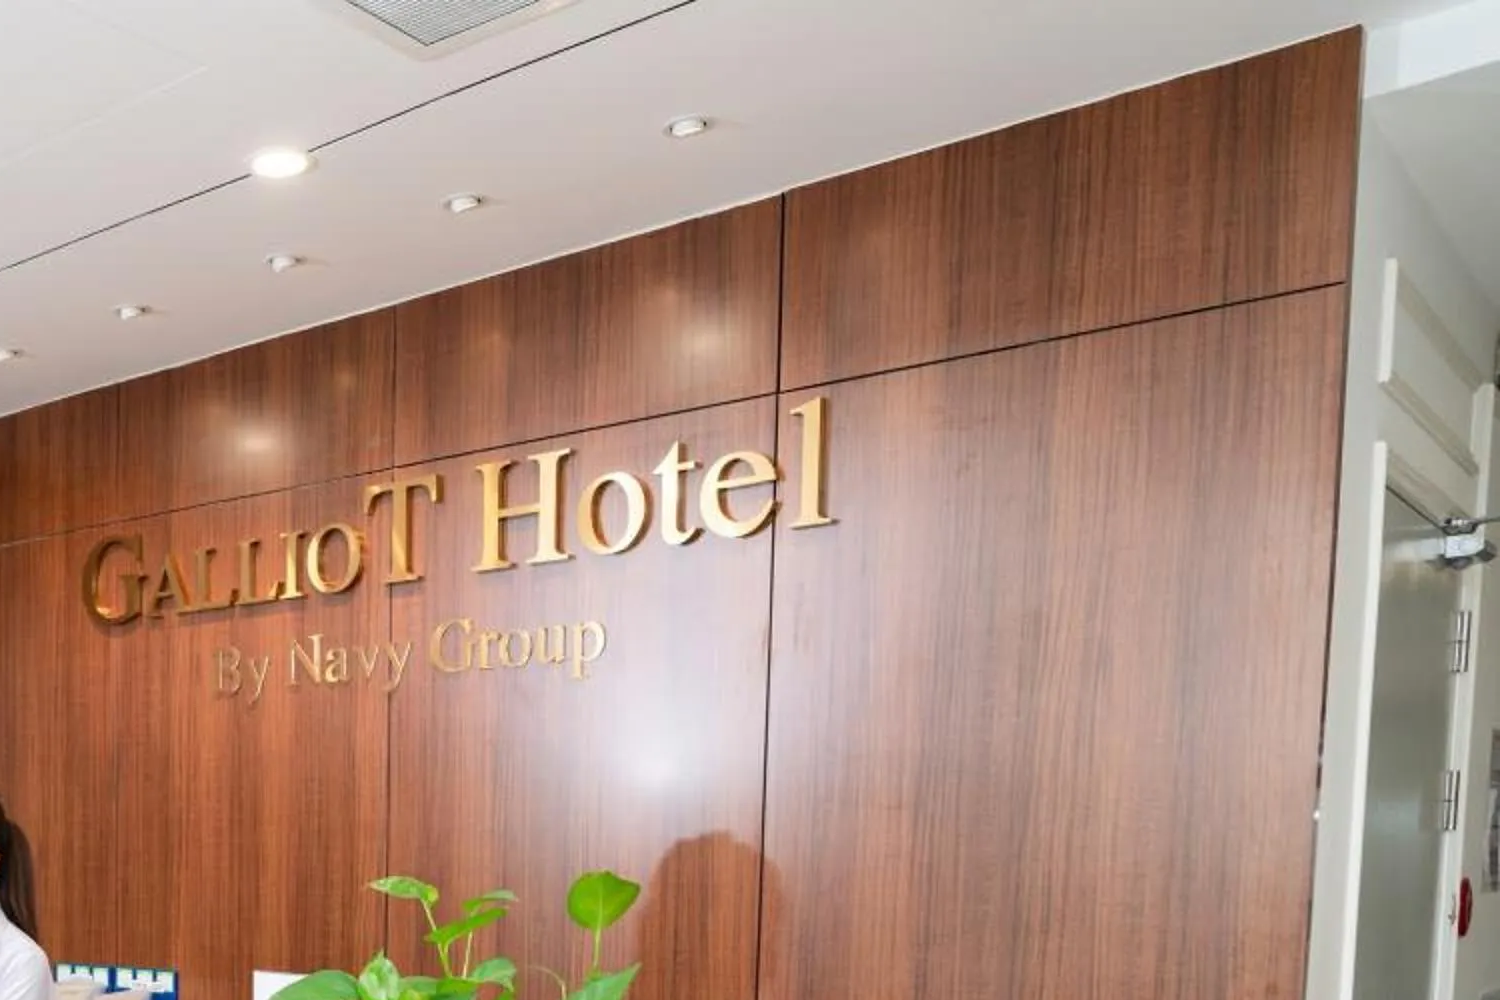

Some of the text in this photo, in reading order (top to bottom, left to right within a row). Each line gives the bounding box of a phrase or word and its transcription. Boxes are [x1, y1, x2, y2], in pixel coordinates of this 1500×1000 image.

[82, 396, 839, 626] GALLIOT Hotel
[215, 617, 608, 706] By Navy Group
